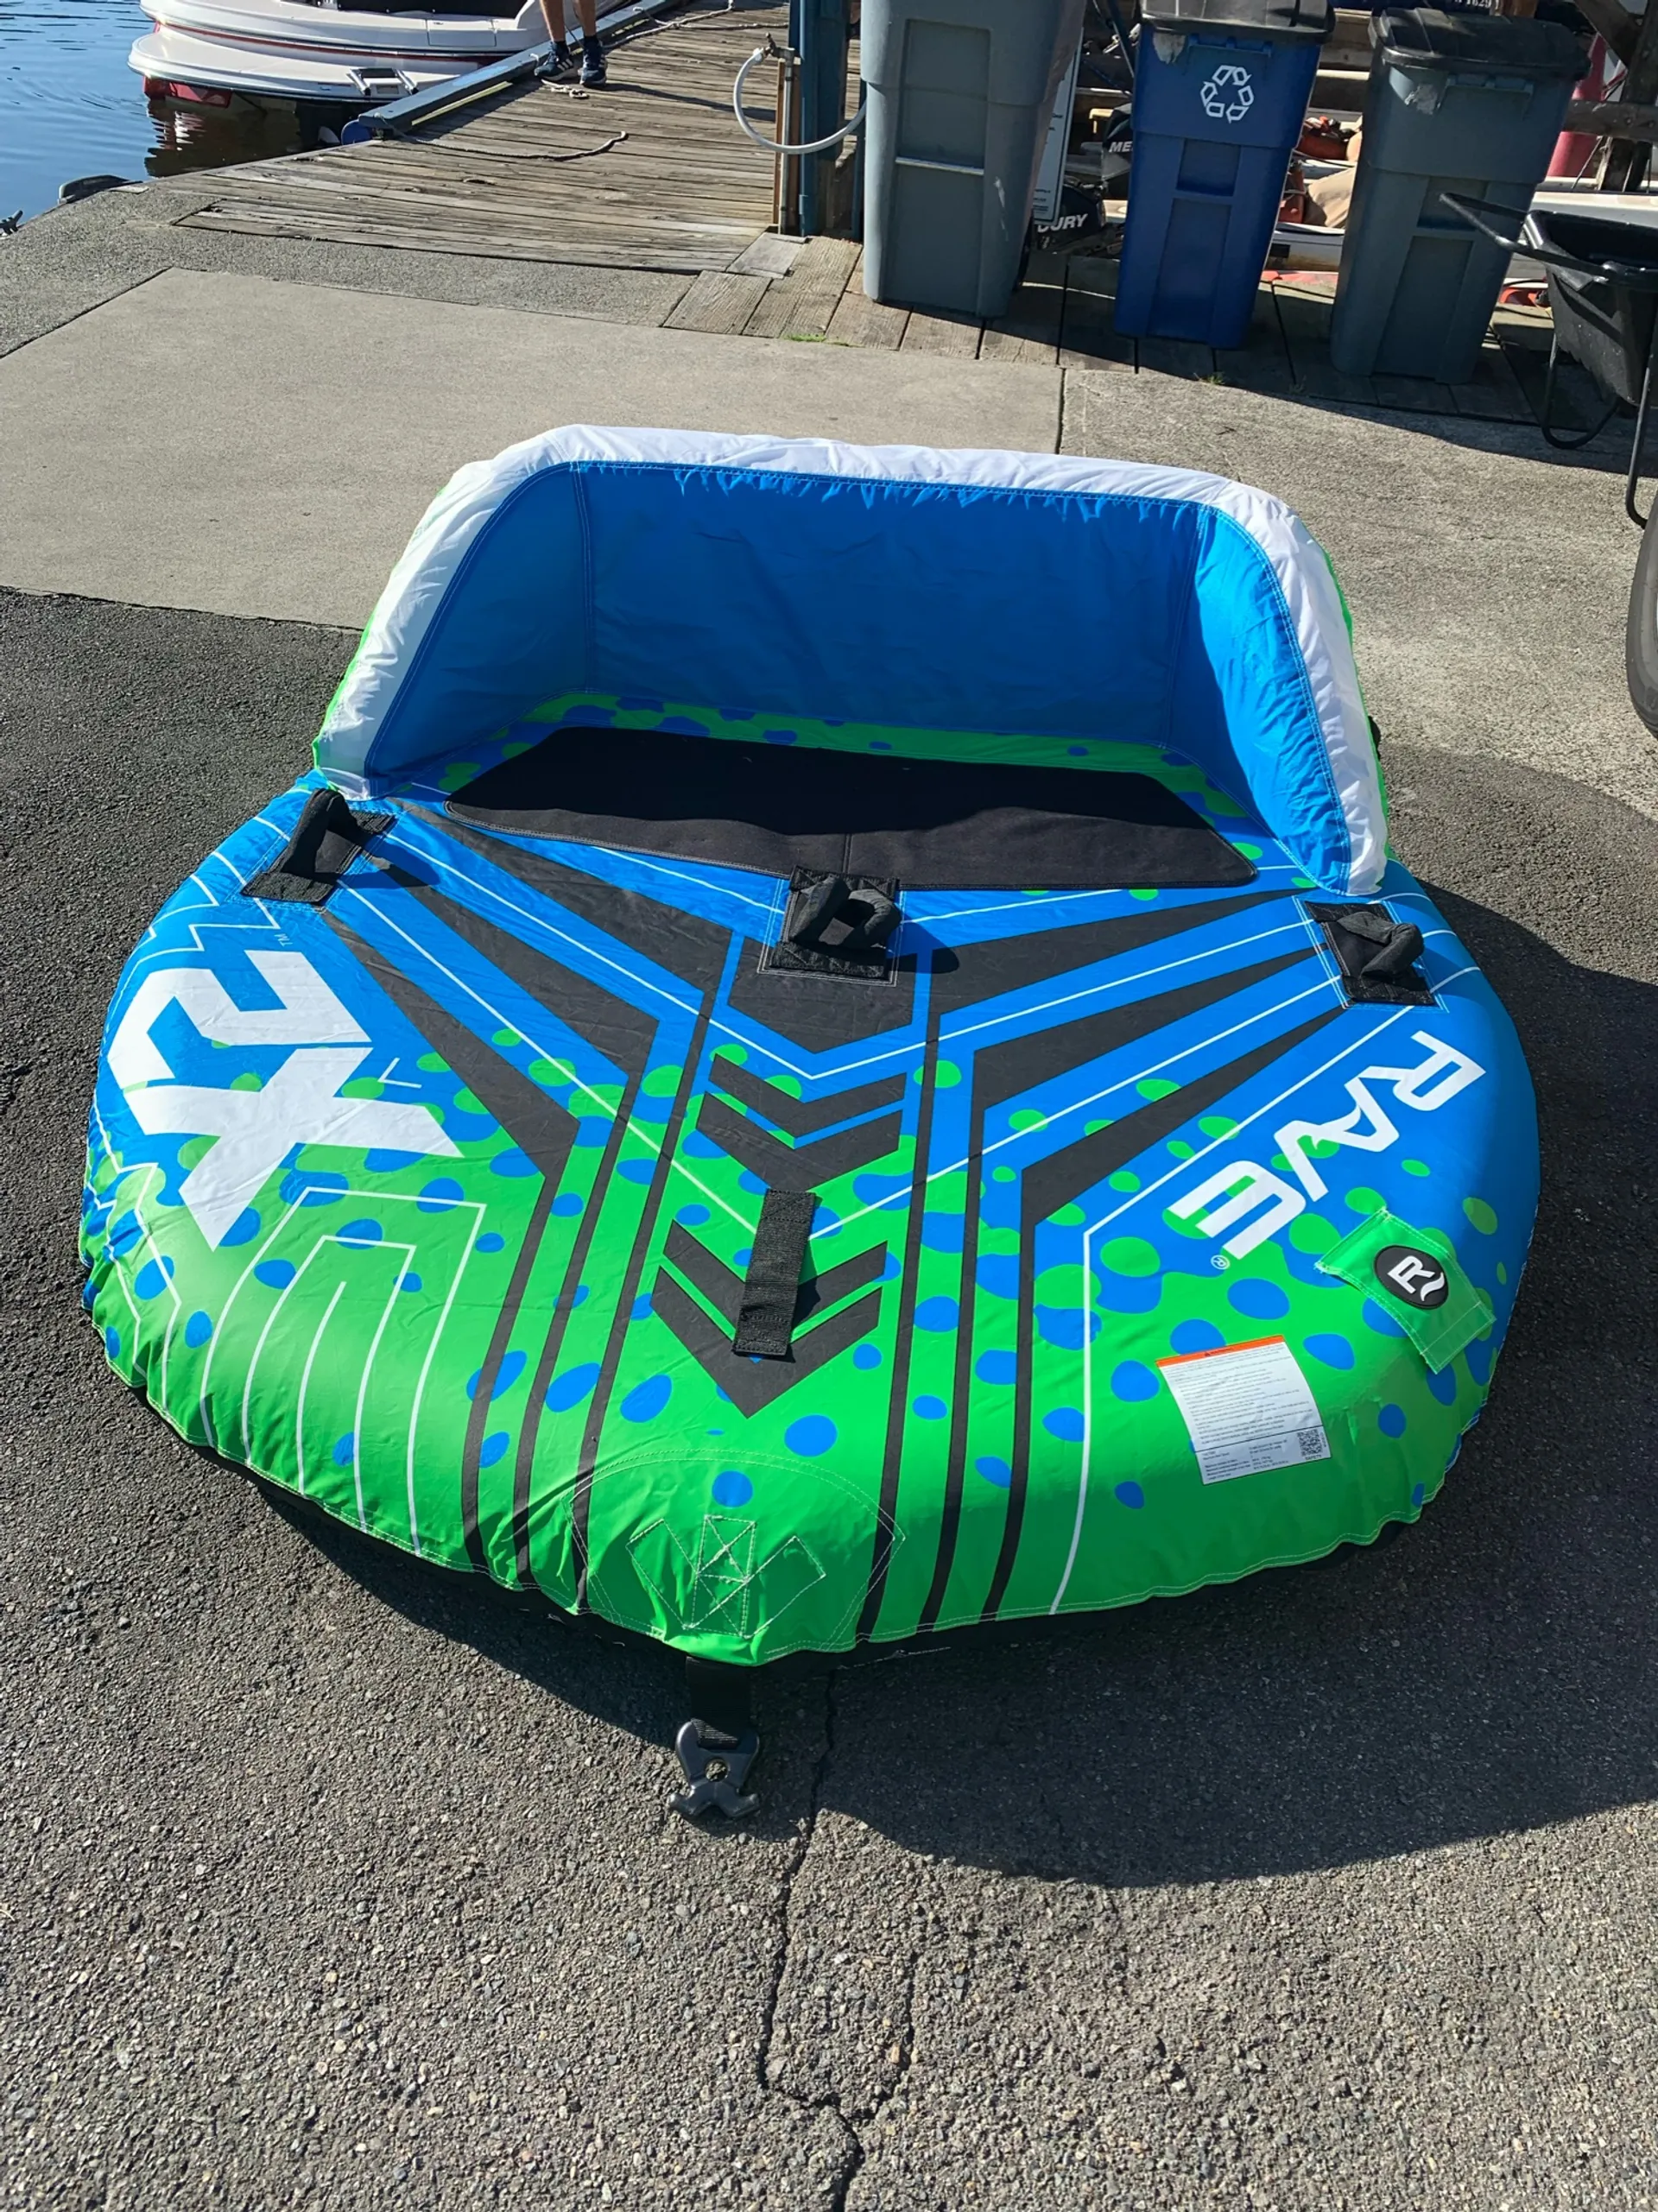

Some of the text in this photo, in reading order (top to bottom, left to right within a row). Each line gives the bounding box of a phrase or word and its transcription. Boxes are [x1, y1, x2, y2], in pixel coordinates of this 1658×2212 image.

[1108, 141, 1133, 153] ME
[107, 950, 465, 1252] X2
[1167, 1030, 1486, 1260] RAVE
